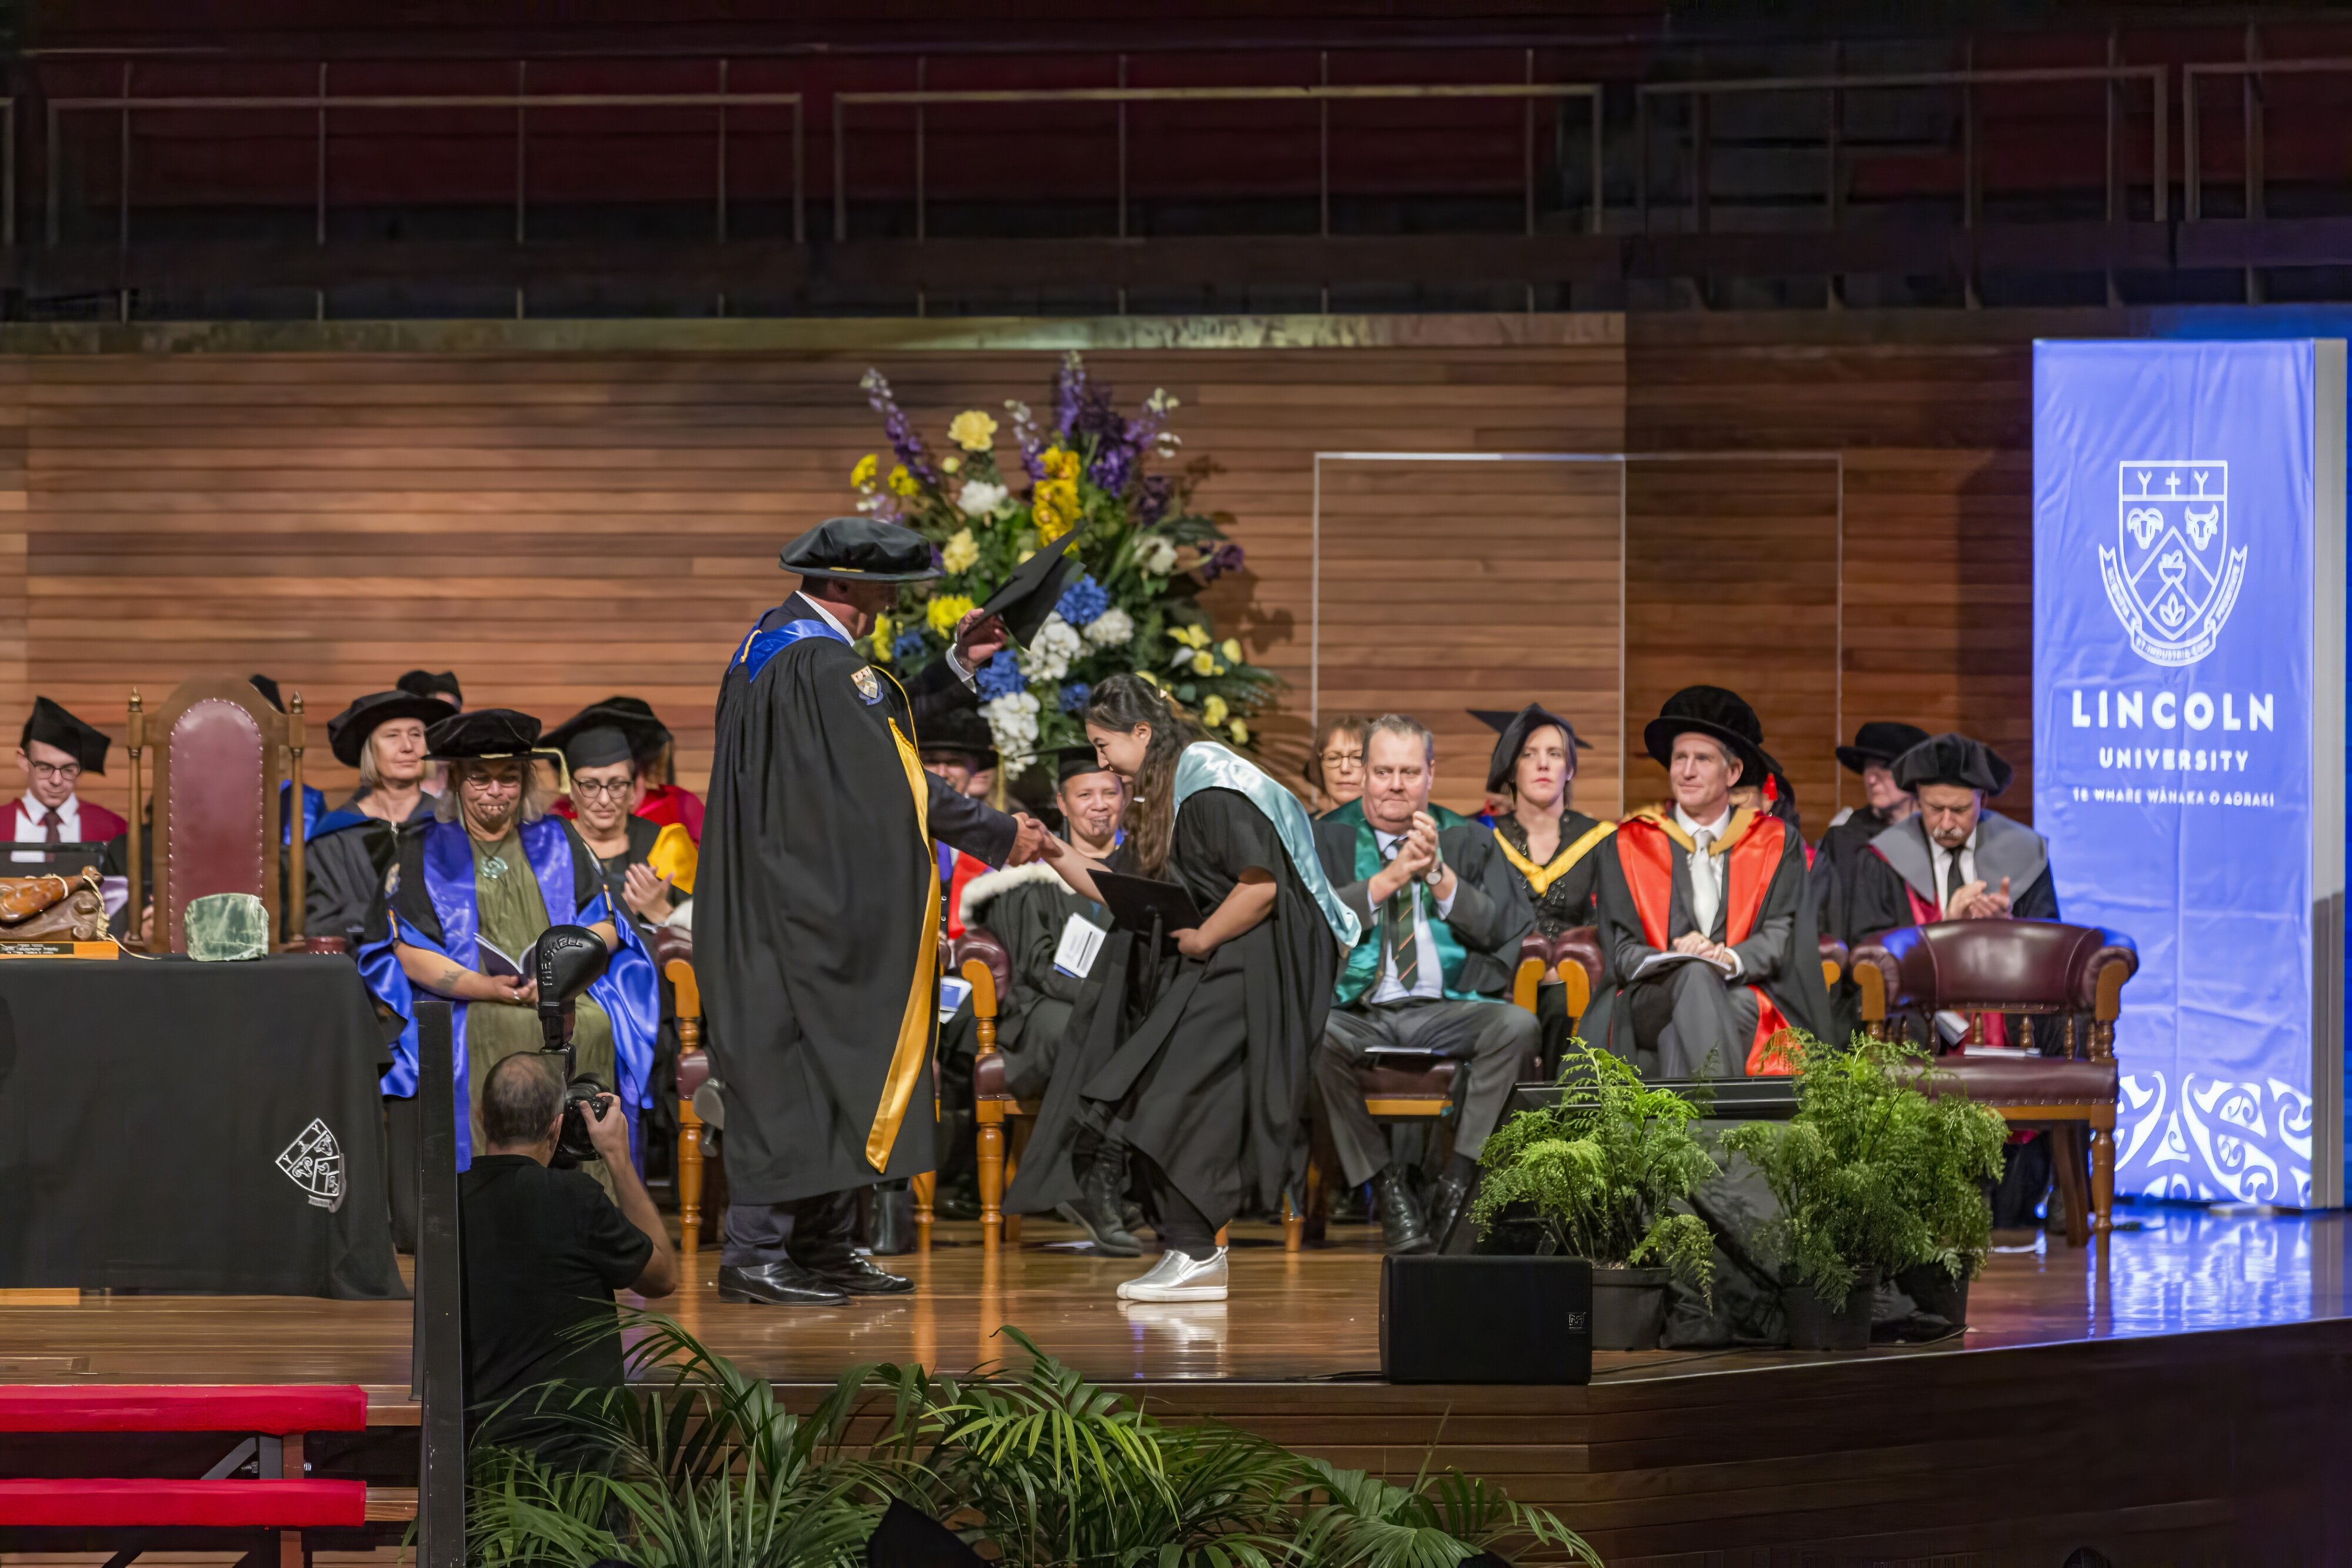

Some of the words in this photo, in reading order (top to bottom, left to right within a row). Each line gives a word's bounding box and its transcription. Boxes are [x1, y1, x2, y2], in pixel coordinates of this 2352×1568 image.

[2072, 690, 2274, 732] LINCOLN
[2099, 747, 2248, 772] UNIVERSITY
[2209, 790, 2220, 805] O
